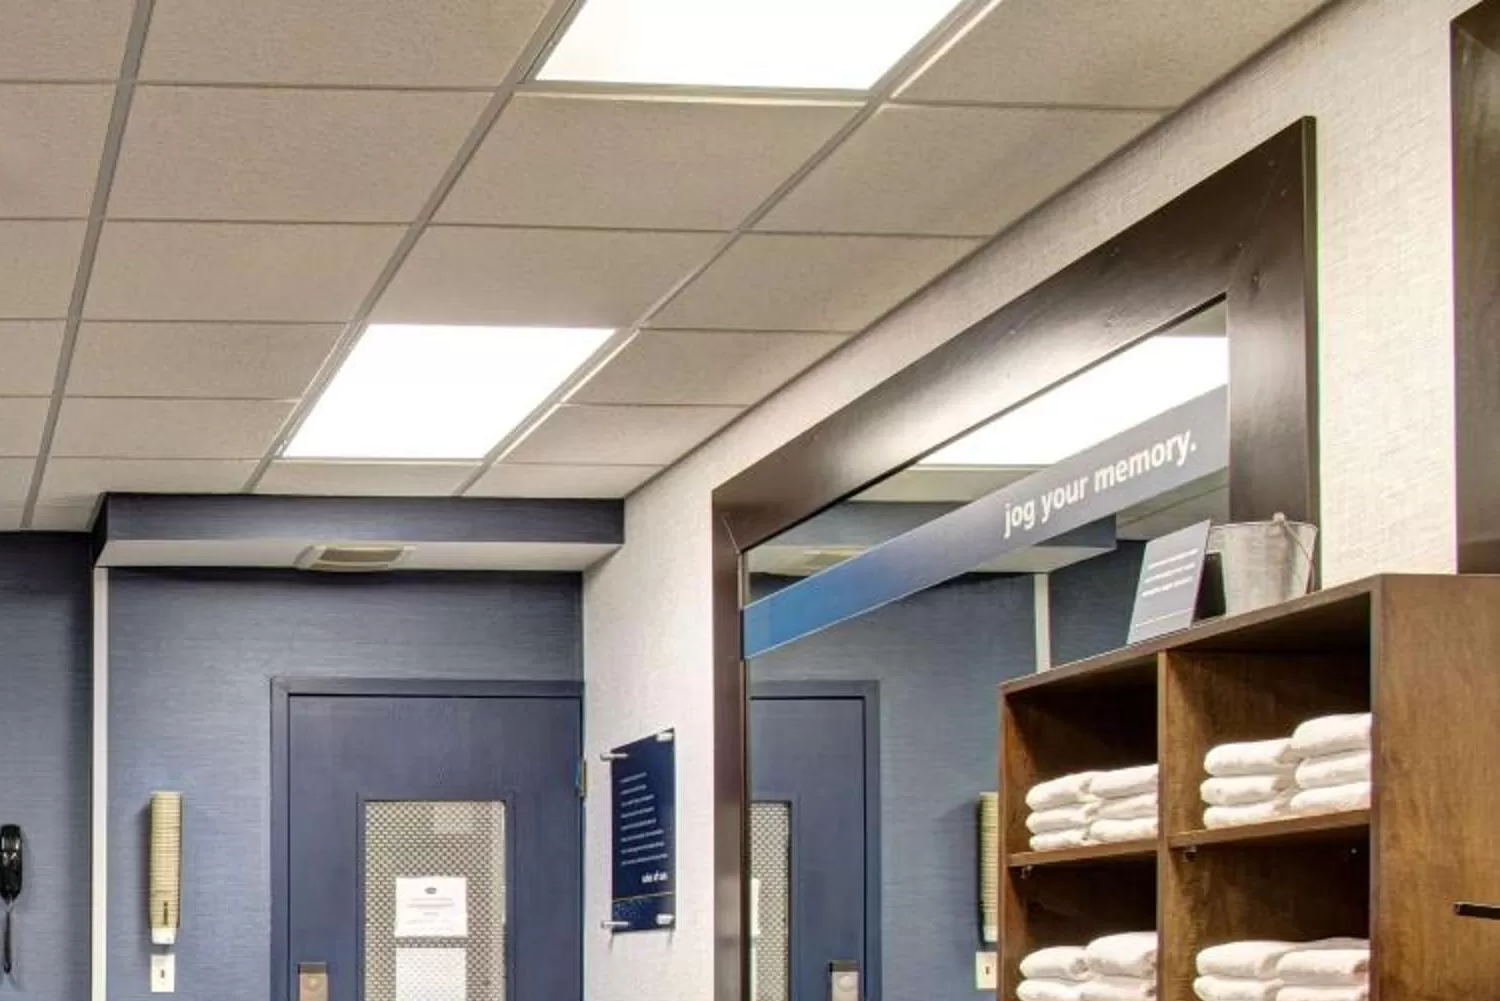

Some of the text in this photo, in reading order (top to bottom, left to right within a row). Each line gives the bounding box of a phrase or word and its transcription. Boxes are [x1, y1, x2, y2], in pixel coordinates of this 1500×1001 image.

[1003, 429, 1197, 539] jog your memory.
